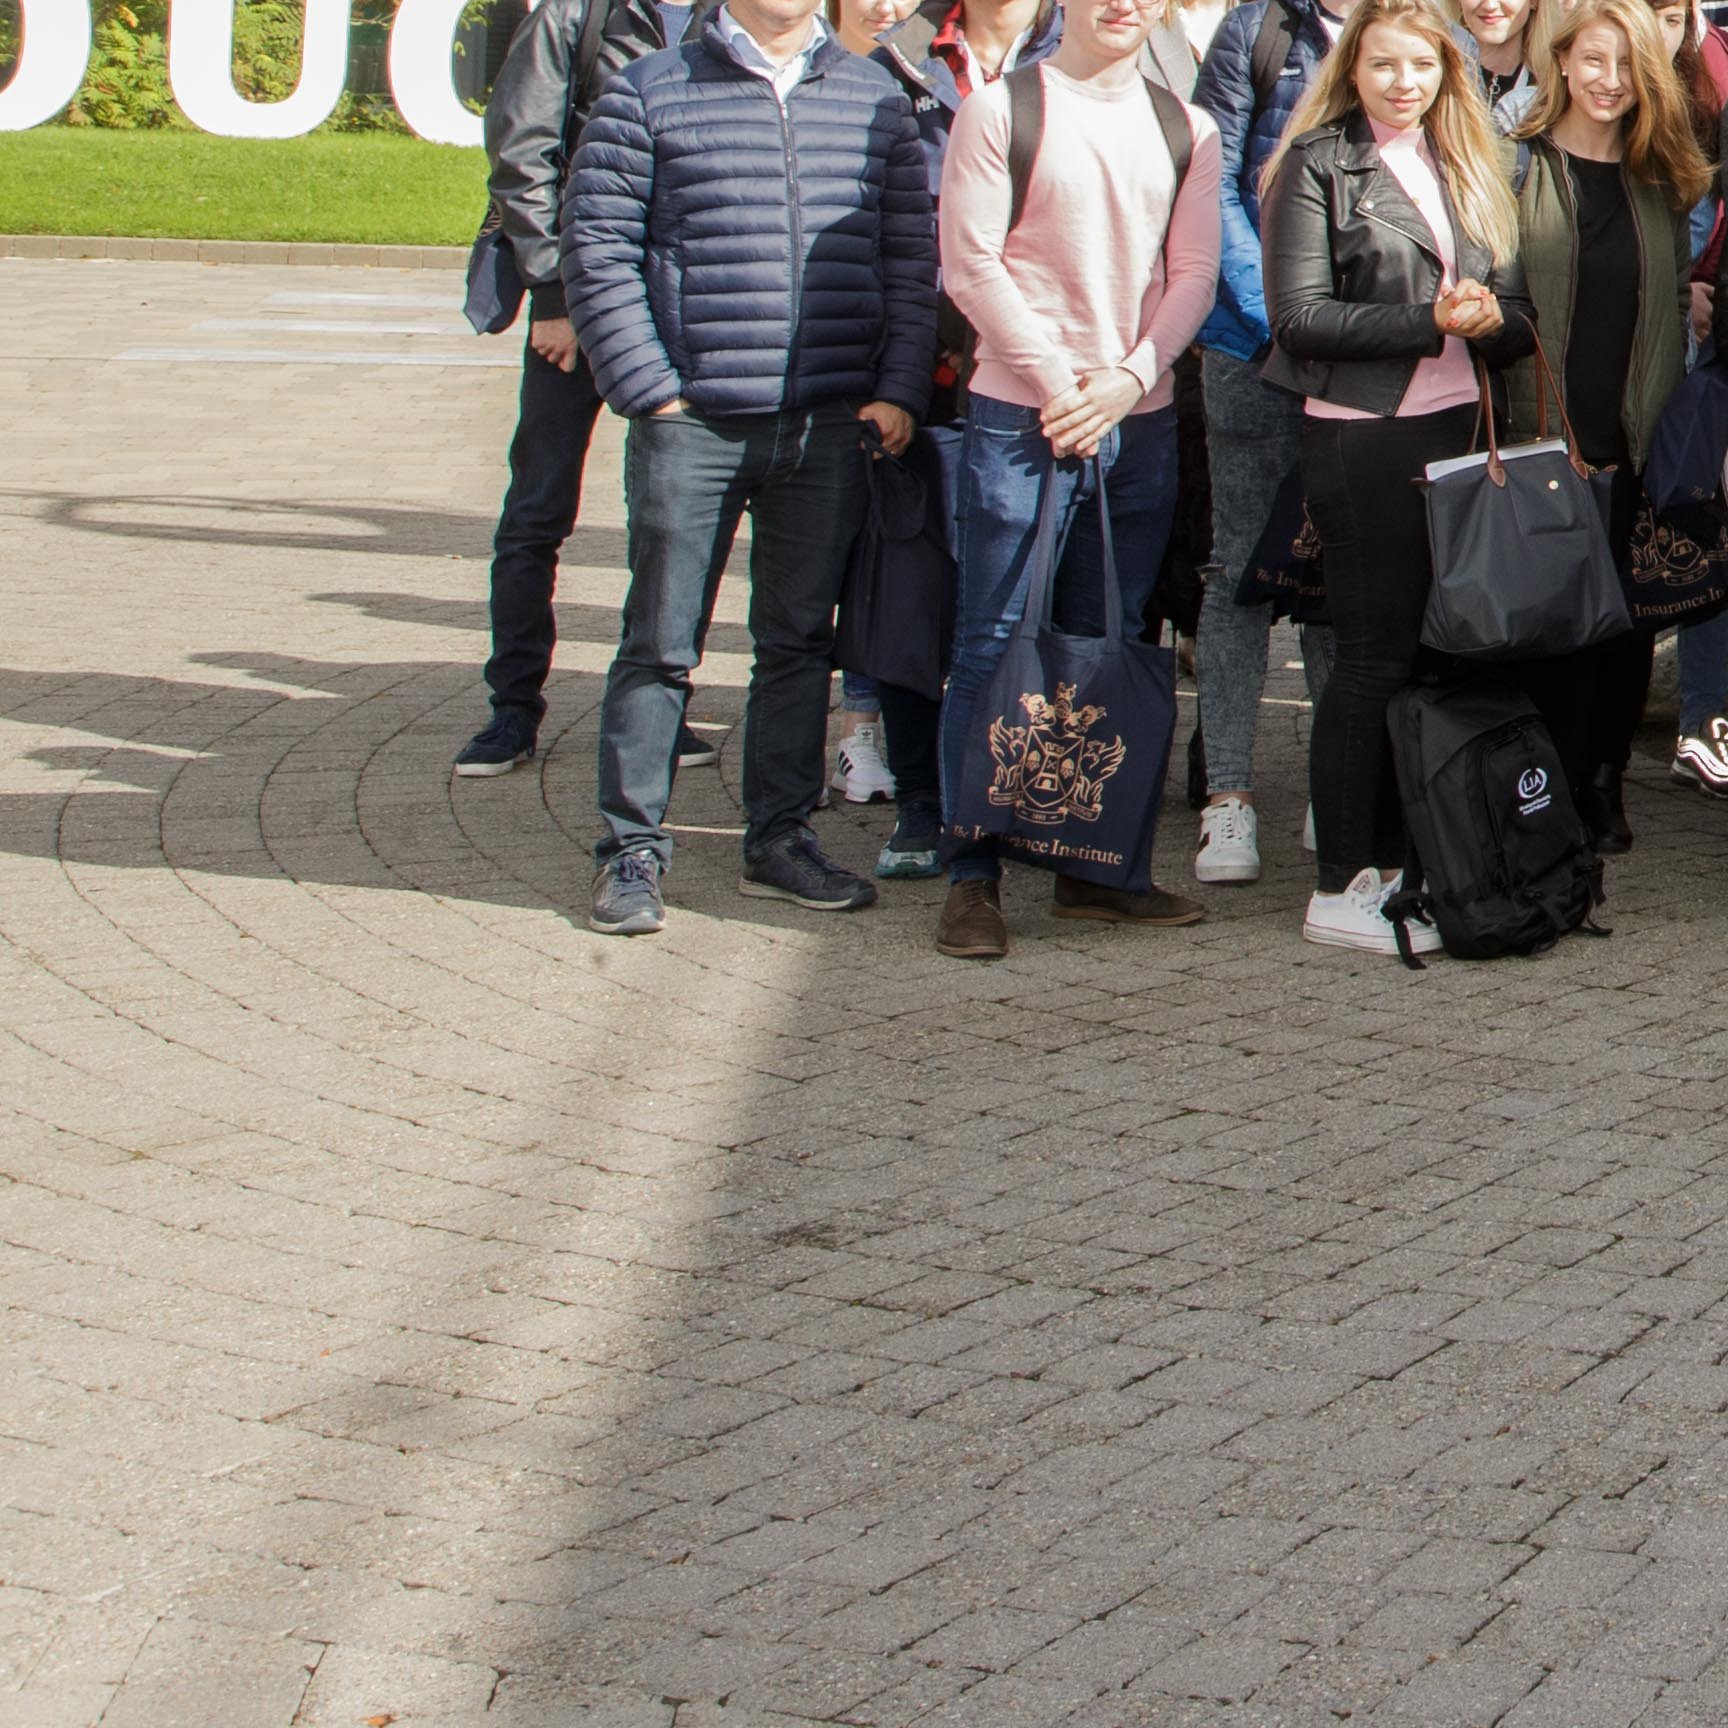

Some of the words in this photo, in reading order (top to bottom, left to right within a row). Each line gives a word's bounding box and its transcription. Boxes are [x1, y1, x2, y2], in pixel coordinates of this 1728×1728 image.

[915, 96, 940, 113] HH
[1523, 774, 1542, 793] LIA
[1050, 838, 1124, 865] Institute
